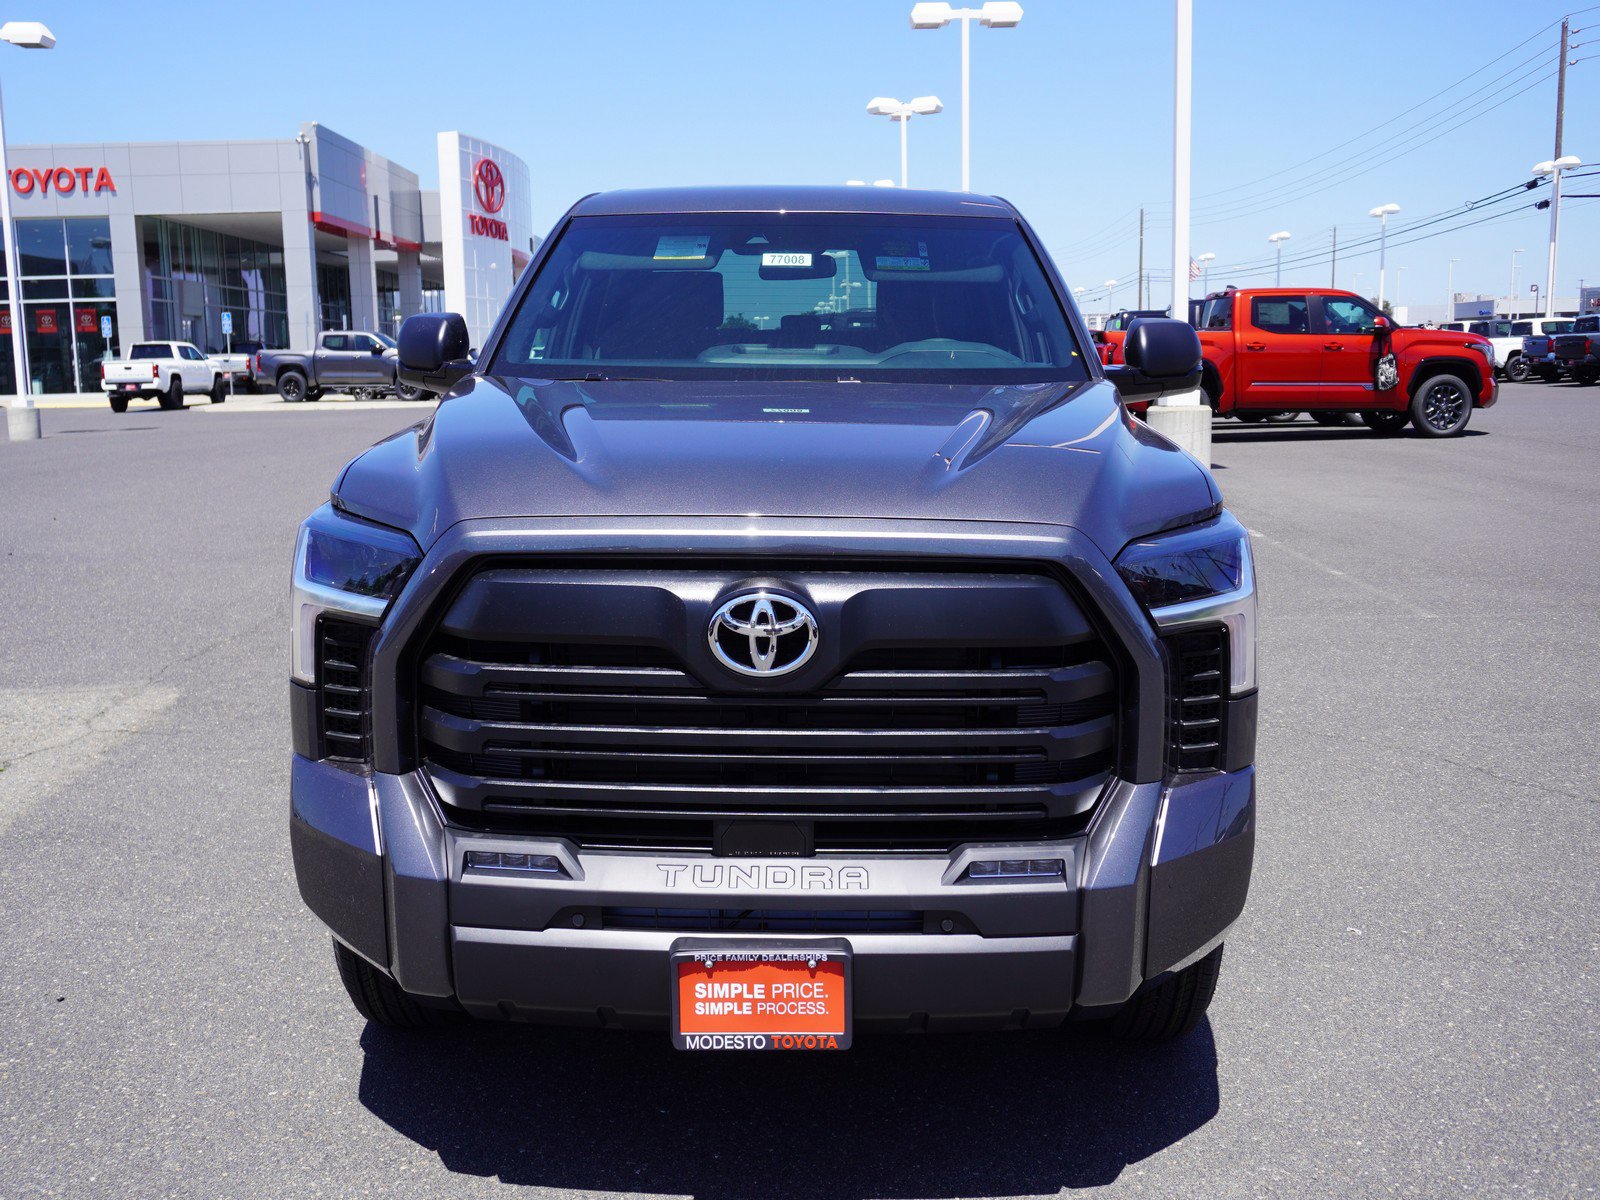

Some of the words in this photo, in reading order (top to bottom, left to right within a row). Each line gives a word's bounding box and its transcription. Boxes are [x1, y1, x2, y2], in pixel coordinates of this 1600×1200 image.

[7, 167, 116, 194] OYOTA
[468, 213, 509, 241] TOYOTA
[770, 255, 805, 264] 77008
[656, 864, 870, 890] TUNDRA
[694, 954, 723, 962] PRICE
[725, 954, 759, 962] FAMILY
[761, 954, 828, 962] DEALERSHIPS
[694, 983, 765, 999] SIMPLE
[771, 983, 829, 999] PRICE.
[694, 1002, 752, 1015] SIMPLE
[757, 1002, 829, 1015] PROCESS.
[686, 1035, 766, 1050] MODESTO
[771, 1035, 838, 1049] TOYOTA
